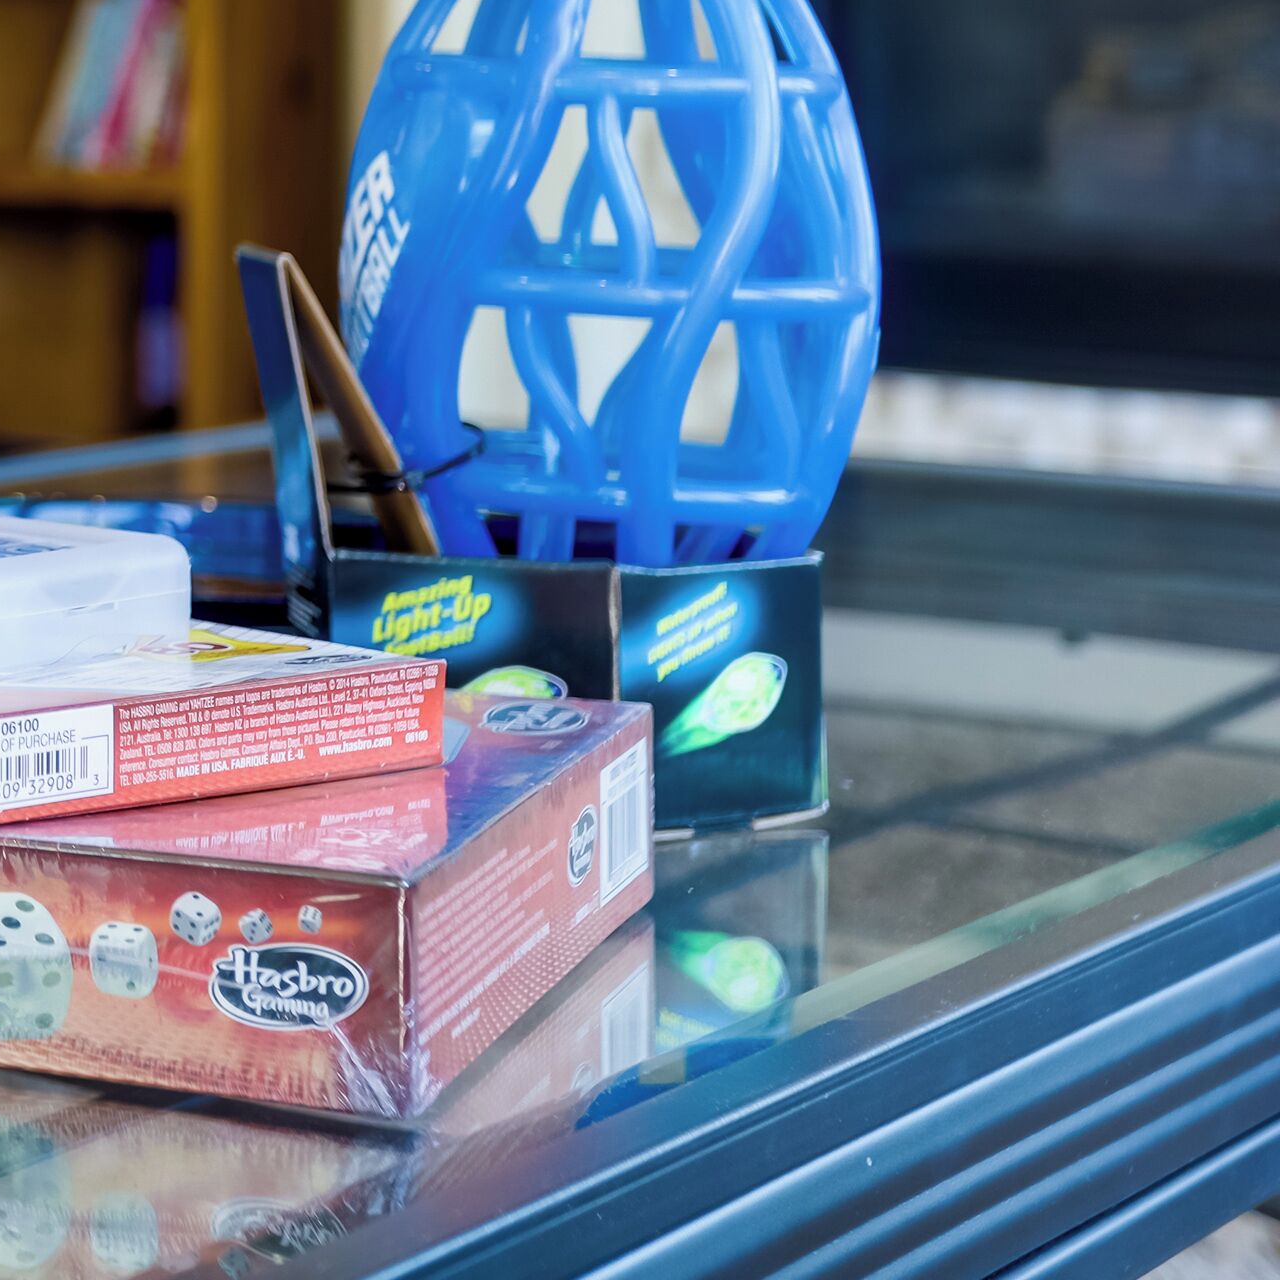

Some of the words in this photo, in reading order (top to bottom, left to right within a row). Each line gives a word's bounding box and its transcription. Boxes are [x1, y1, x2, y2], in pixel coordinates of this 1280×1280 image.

[381, 575, 473, 614] Amazing
[372, 593, 492, 643] Light-Up
[1, 718, 40, 736] 06100
[0, 738, 15, 753] OF
[18, 729, 77, 750] PURCHASE
[319, 737, 391, 756] www.hasbro.com
[176, 764, 199, 777] MADE
[201, 763, 209, 773] IN
[270, 751, 285, 762] AUX
[28, 774, 74, 796] 32908
[218, 949, 354, 998] Hasbro
[242, 985, 329, 1025] Gaming
